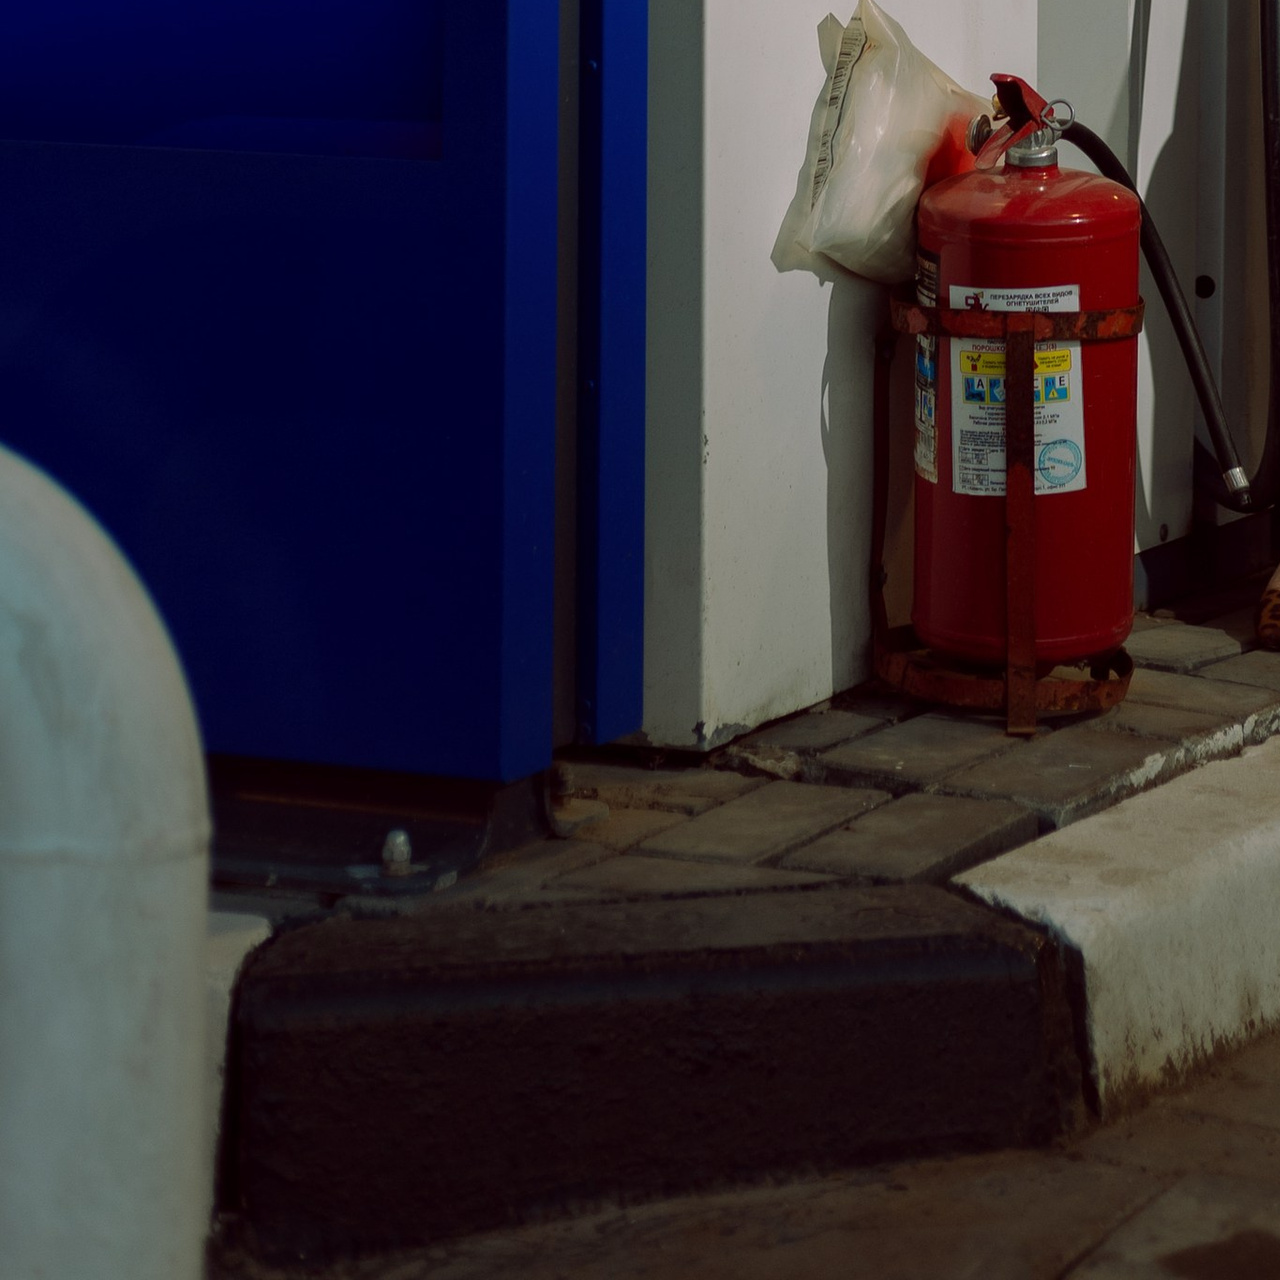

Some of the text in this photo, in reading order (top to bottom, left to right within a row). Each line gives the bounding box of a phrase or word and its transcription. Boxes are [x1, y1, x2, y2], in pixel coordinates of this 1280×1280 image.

[990, 290, 1073, 301] ПЕРЕЗАРЯДКА ВСЕХ ВИДОВ
[1006, 298, 1060, 306] ОГНЕТУШИТЕЛЕЙ
